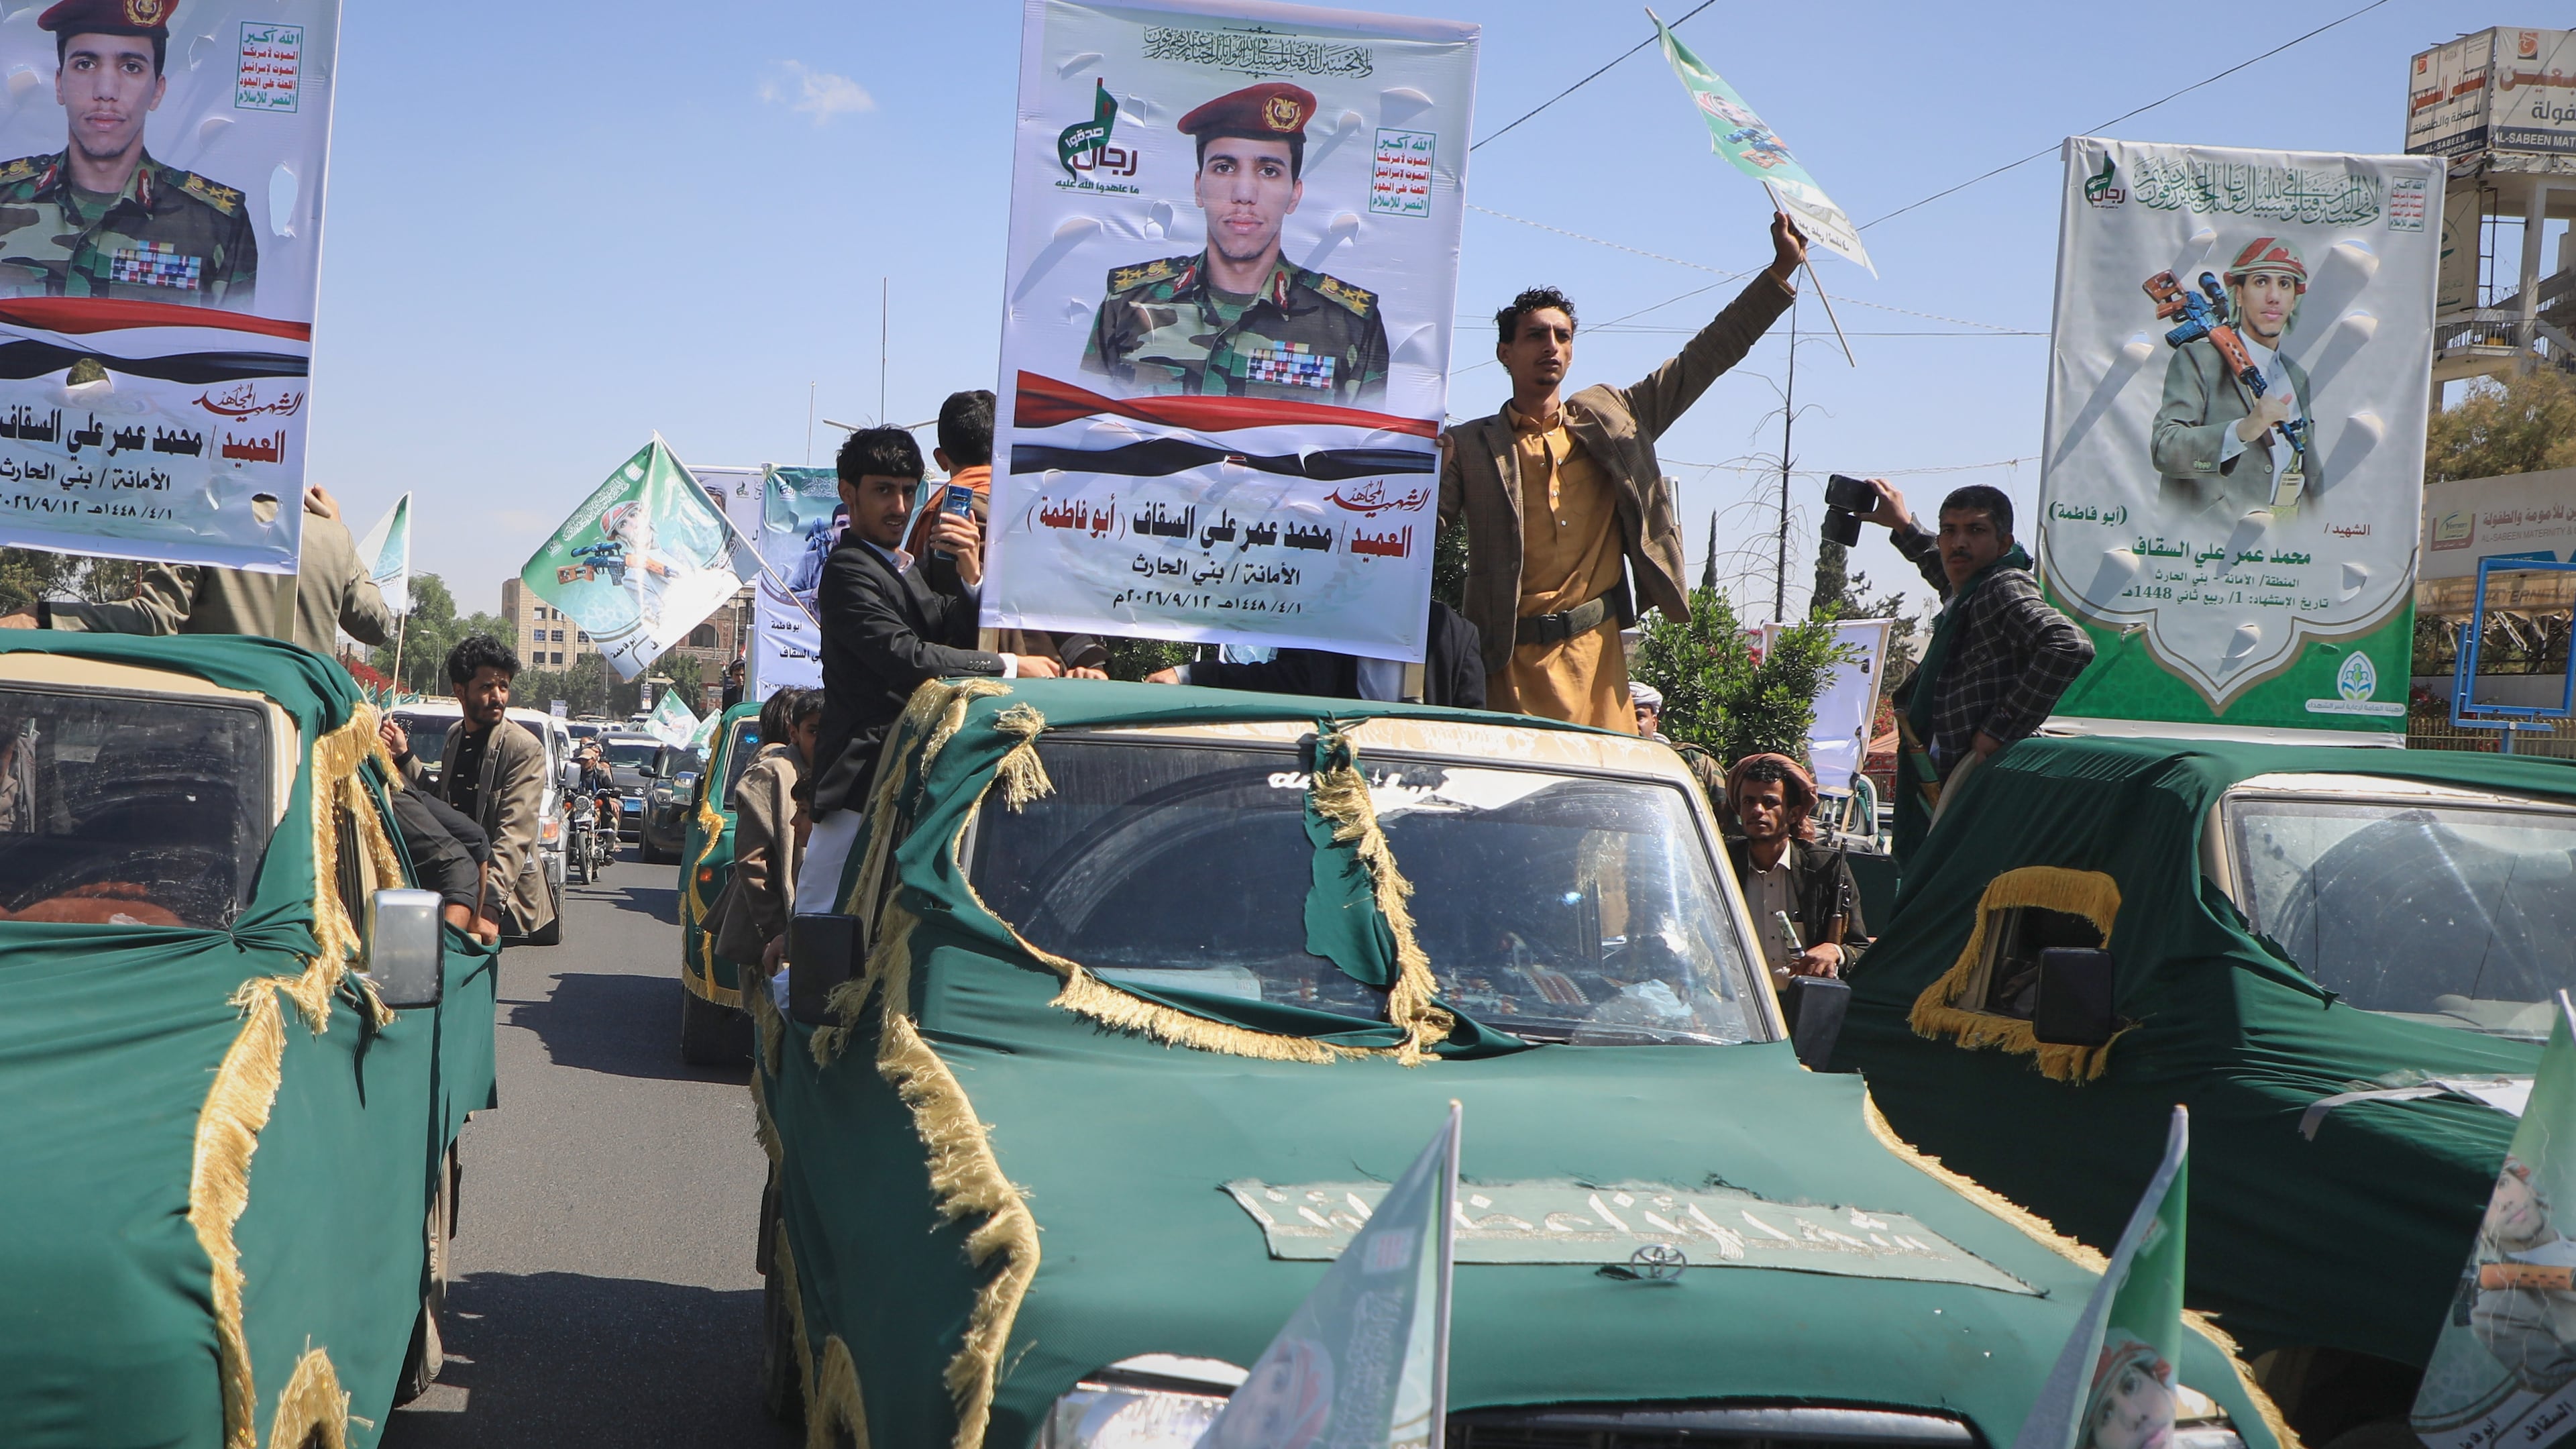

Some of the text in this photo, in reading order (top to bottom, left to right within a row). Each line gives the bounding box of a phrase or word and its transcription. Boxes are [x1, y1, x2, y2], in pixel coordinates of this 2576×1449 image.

[243, 27, 299, 46] الله أكبر
[274, 50, 298, 61] الموت
[272, 66, 297, 76] الموت
[239, 77, 296, 90] اللعنة على اليهود
[2448, 68, 2487, 105] مستشفى
[238, 90, 294, 107] النصر للإسلام
[2414, 115, 2449, 135] والطفولة
[1065, 127, 1104, 148] صدقوا
[1378, 134, 1432, 152] الله أكبر
[2424, 134, 2466, 153] AL-SABEEN
[2493, 132, 2551, 146] AL-SABEEN
[1073, 145, 1138, 176] رجال
[1407, 156, 1431, 166] الموت
[1405, 171, 1430, 181] الموت
[1055, 178, 1140, 194] ما عاهدوا الله عليه
[1374, 182, 1428, 195] اللعنة على اليهود
[1373, 195, 1427, 211] النصر للإسلام
[2092, 188, 2125, 204] رجال
[0, 404, 62, 444] السقاف
[67, 412, 104, 462] علي
[107, 425, 146, 457] عمر
[152, 425, 203, 458] محمد
[222, 429, 286, 469] العميد
[0, 458, 55, 482] الحارث
[60, 465, 93, 491] بني
[112, 467, 170, 491] الأمانة
[1133, 501, 1196, 540] السقاف
[2483, 510, 2522, 528] والطفولة
[2526, 502, 2564, 524] للأمومة
[1200, 508, 1237, 556] علي
[1240, 521, 1278, 553] عمر
[1283, 521, 1333, 553] محمد
[2332, 523, 2371, 538] الشهيد
[2481, 531, 2521, 542] AL-SABEEN
[2524, 527, 2565, 537] MATERNITY
[1350, 525, 1413, 564] العميد
[2131, 536, 2311, 568] محمد عمر علي السقاف
[1132, 553, 1188, 578] الحارث
[1192, 561, 1225, 586] بني
[1244, 561, 1301, 585] الأمانة
[2155, 569, 2188, 583] الحارث
[2192, 572, 2208, 586] بني
[2224, 572, 2255, 586] الأمانة
[2122, 585, 2172, 600] 1448هـ
[2177, 588, 2198, 604] ثاني
[2203, 594, 2224, 605] ربيع
[2300, 596, 2329, 610] تاريخ
[771, 621, 792, 630] فاطمة
[780, 646, 810, 658] السقاف
[2524, 1401, 2574, 1442] السقاف
